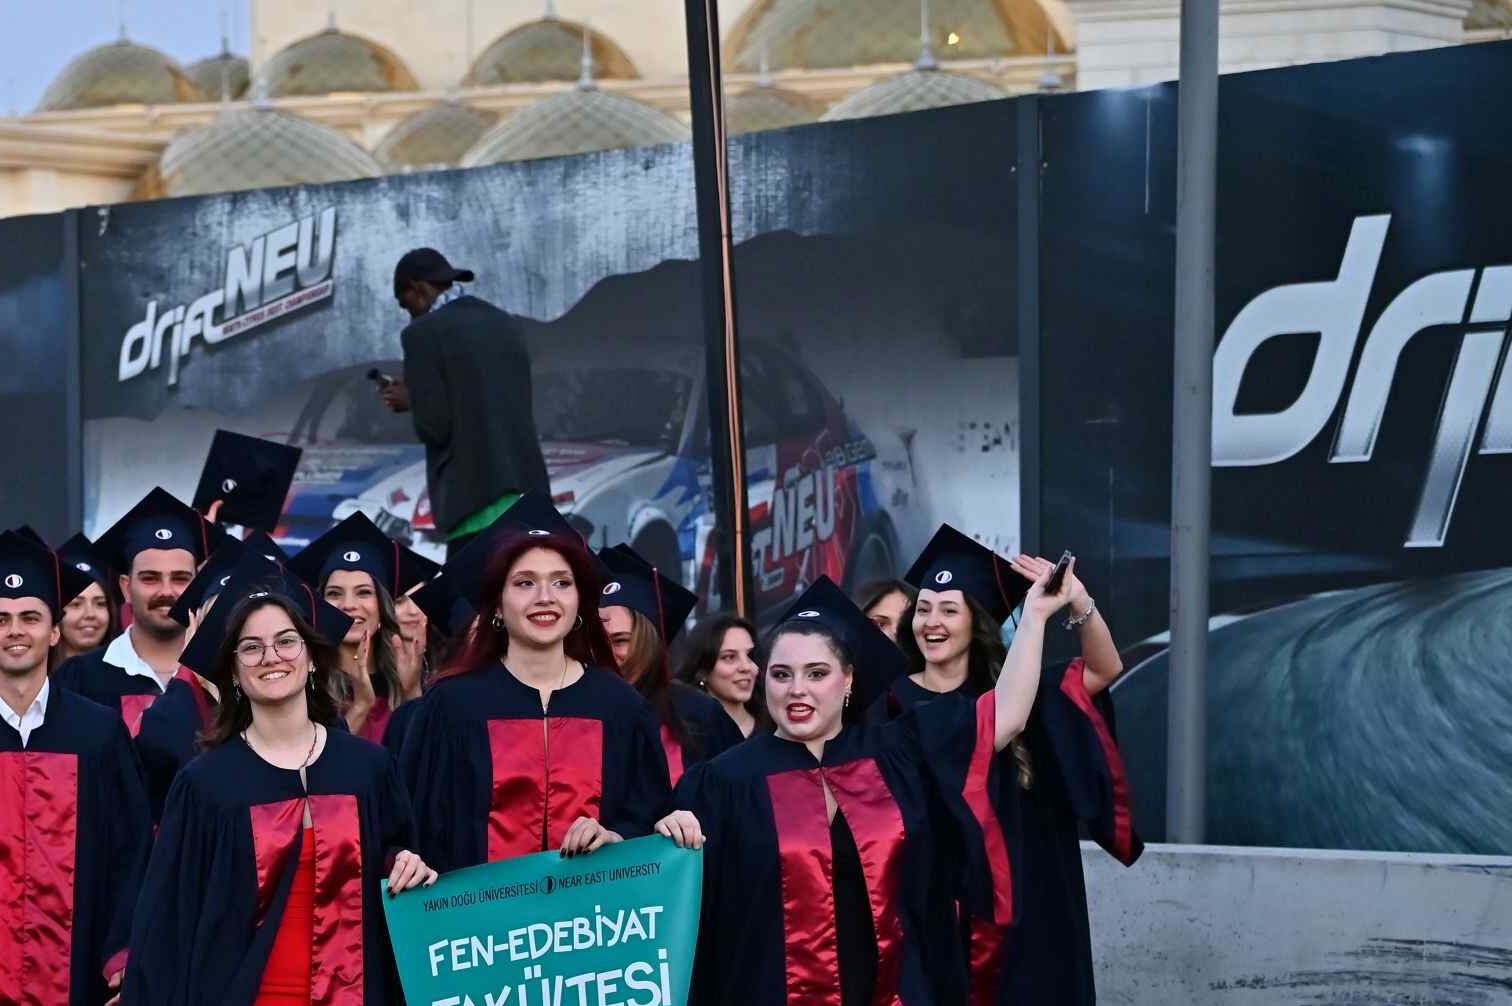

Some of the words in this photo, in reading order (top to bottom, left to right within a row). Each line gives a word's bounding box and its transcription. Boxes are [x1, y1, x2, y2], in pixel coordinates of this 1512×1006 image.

[558, 874, 583, 889] NEAR
[585, 870, 606, 884] EAST
[609, 861, 662, 881] UNIVERSITY
[424, 895, 449, 912] YAKIN
[429, 905, 663, 976] FEN-EDEBİYAT
